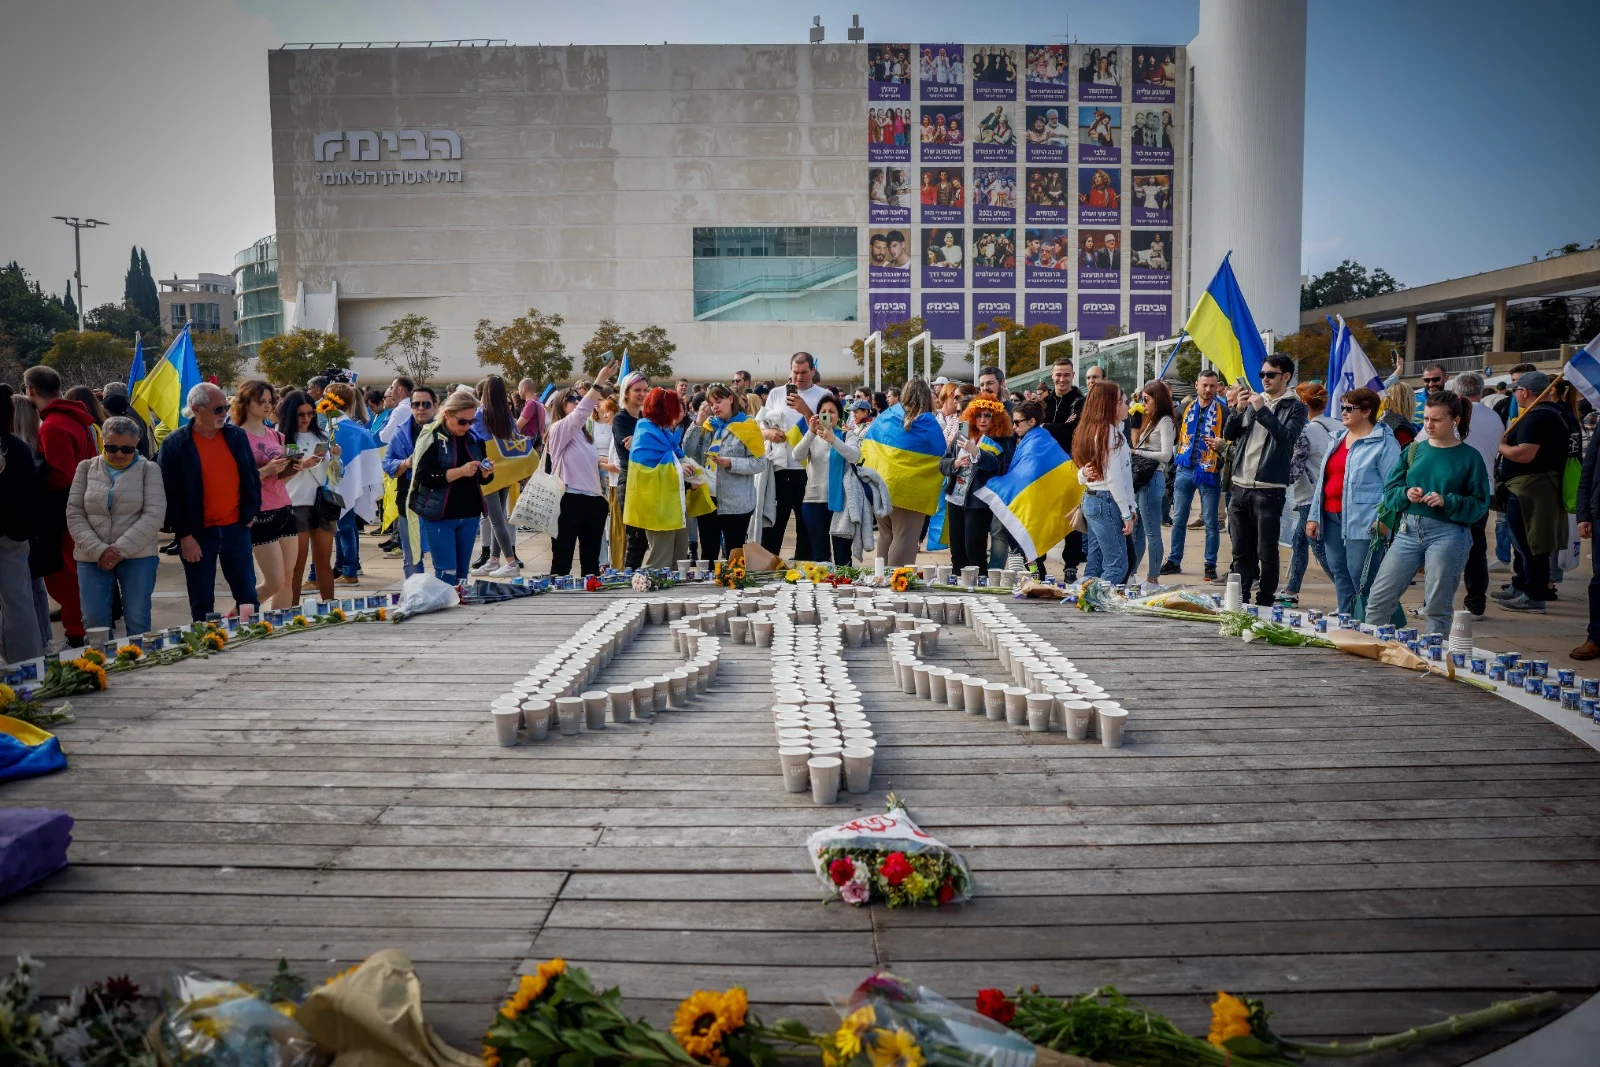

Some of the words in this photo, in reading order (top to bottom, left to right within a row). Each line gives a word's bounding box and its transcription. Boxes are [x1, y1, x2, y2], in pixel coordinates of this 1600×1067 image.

[315, 168, 378, 185] הלאומי
[380, 168, 462, 186] התיאטרון
[979, 209, 992, 217] 2021
